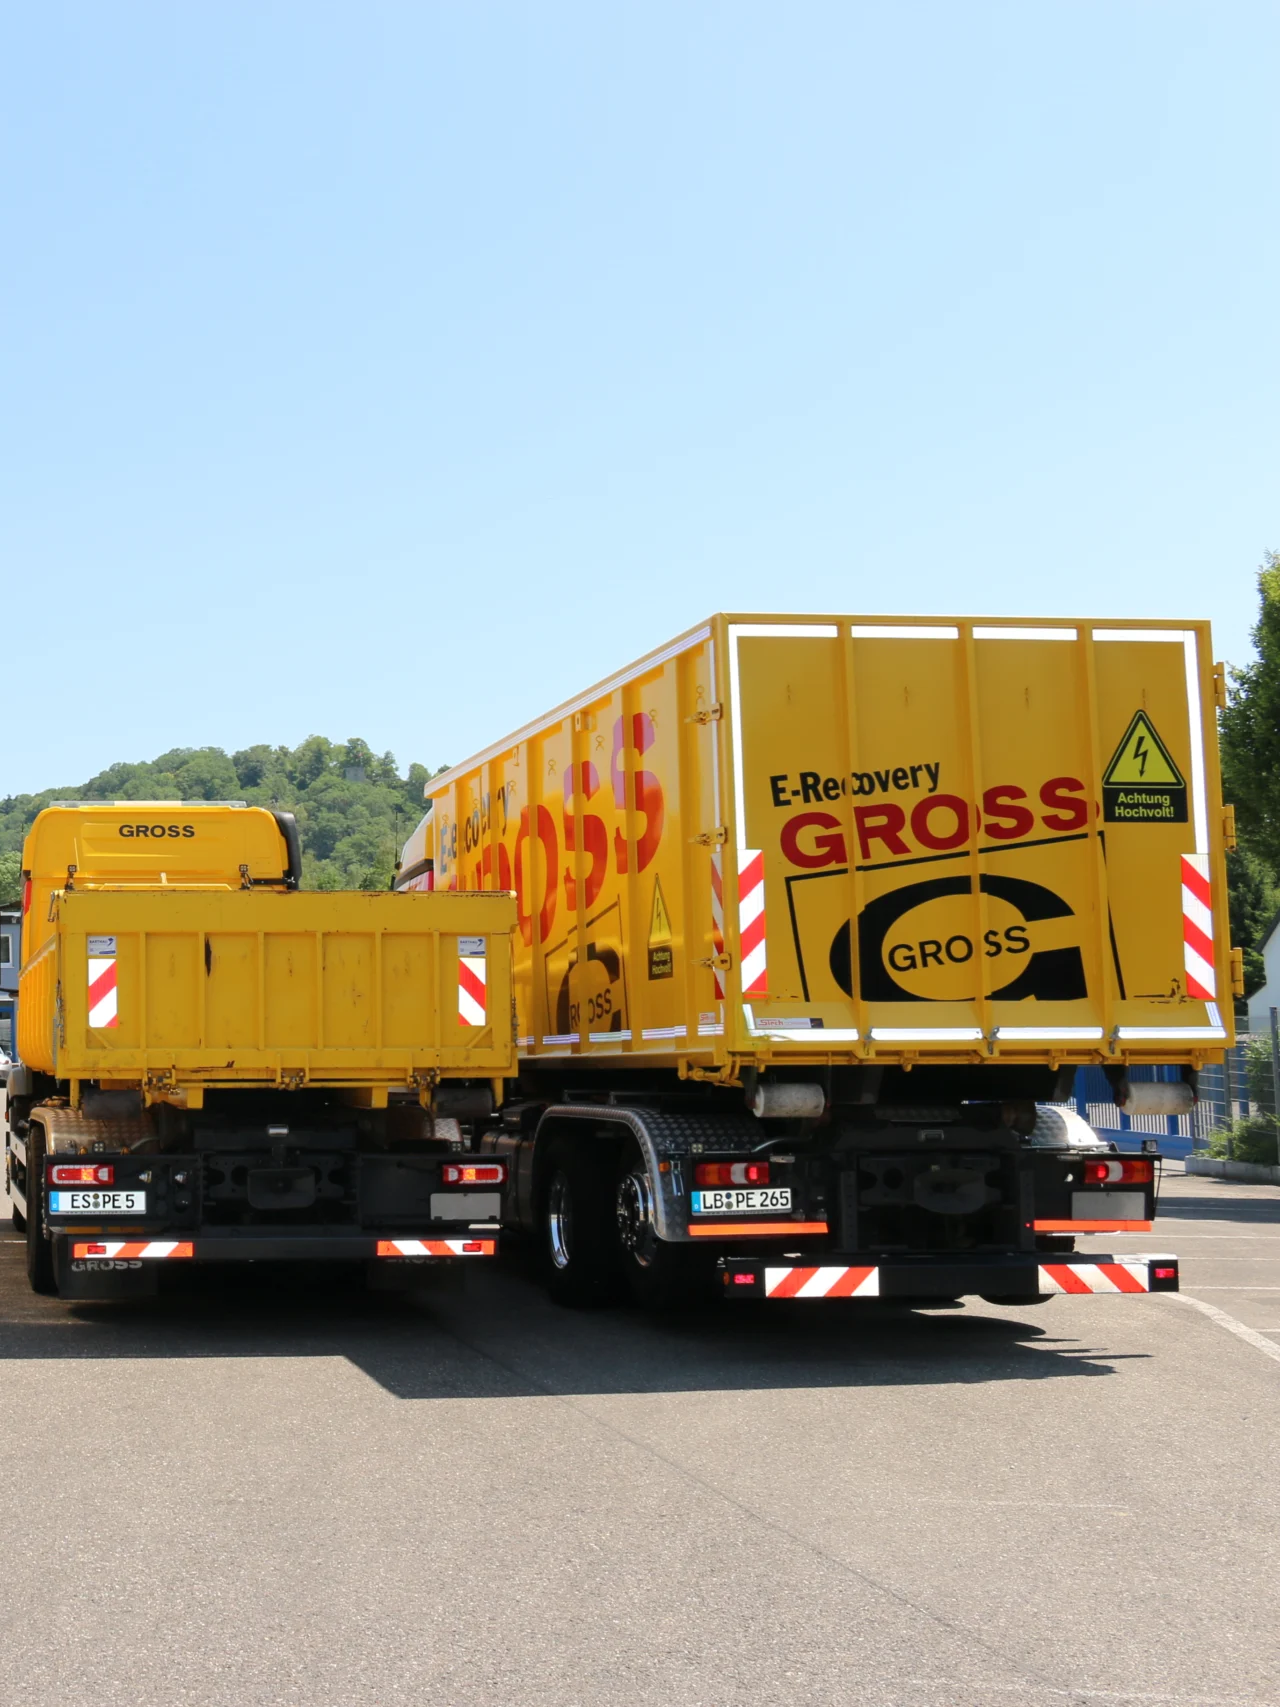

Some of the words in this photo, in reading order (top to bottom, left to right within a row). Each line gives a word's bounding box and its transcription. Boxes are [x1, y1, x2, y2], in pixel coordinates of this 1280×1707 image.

[1117, 792, 1170, 806] Achtung
[1115, 806, 1175, 817] Hochvolt!
[780, 776, 1100, 869] GROSS
[119, 824, 195, 838] GROSS
[888, 926, 1030, 972] GROSS
[71, 1194, 91, 1209] ES
[102, 1194, 122, 1209] PE
[126, 1194, 135, 1209] 5
[703, 1193, 724, 1209] LB
[736, 1192, 756, 1208] PE
[760, 1191, 790, 1206] 265
